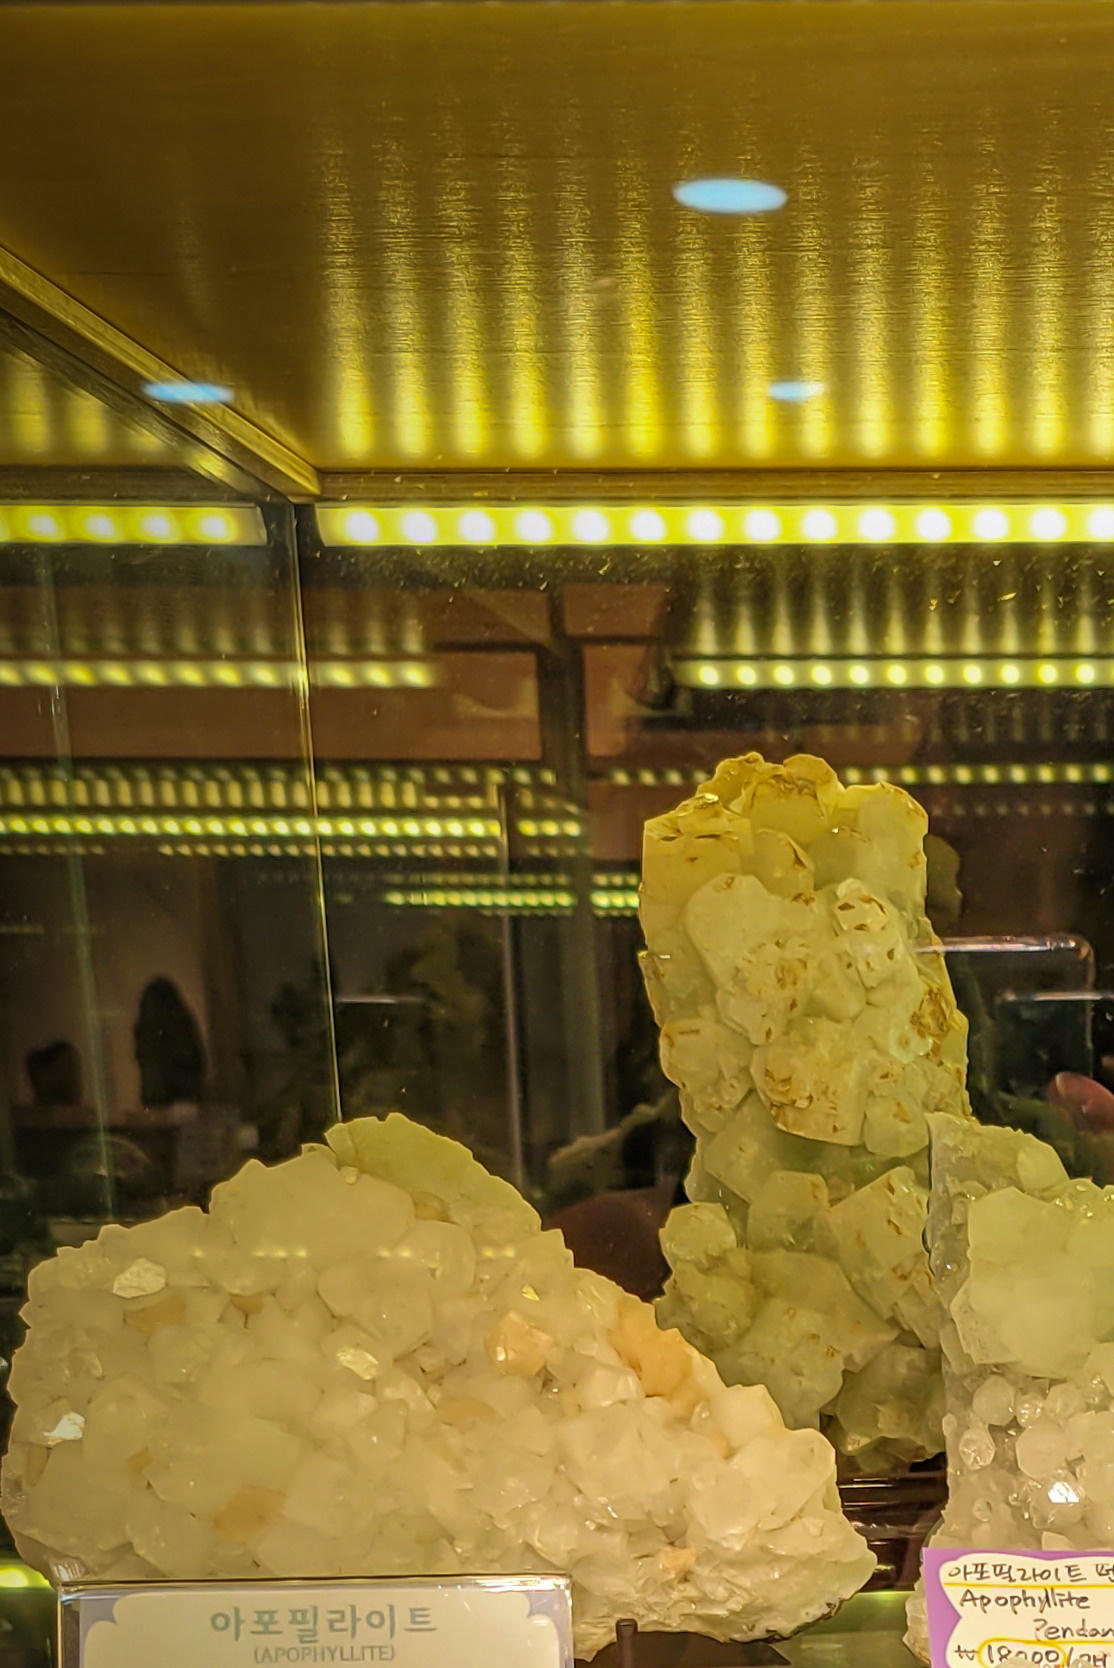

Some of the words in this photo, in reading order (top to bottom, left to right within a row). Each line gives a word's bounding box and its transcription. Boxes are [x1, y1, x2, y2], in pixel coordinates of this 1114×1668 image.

[959, 1588, 1091, 1614] Apophyllite
[210, 1603, 438, 1644] 아포필라이트
[254, 1645, 395, 1665] (APOPHYLLITE)
